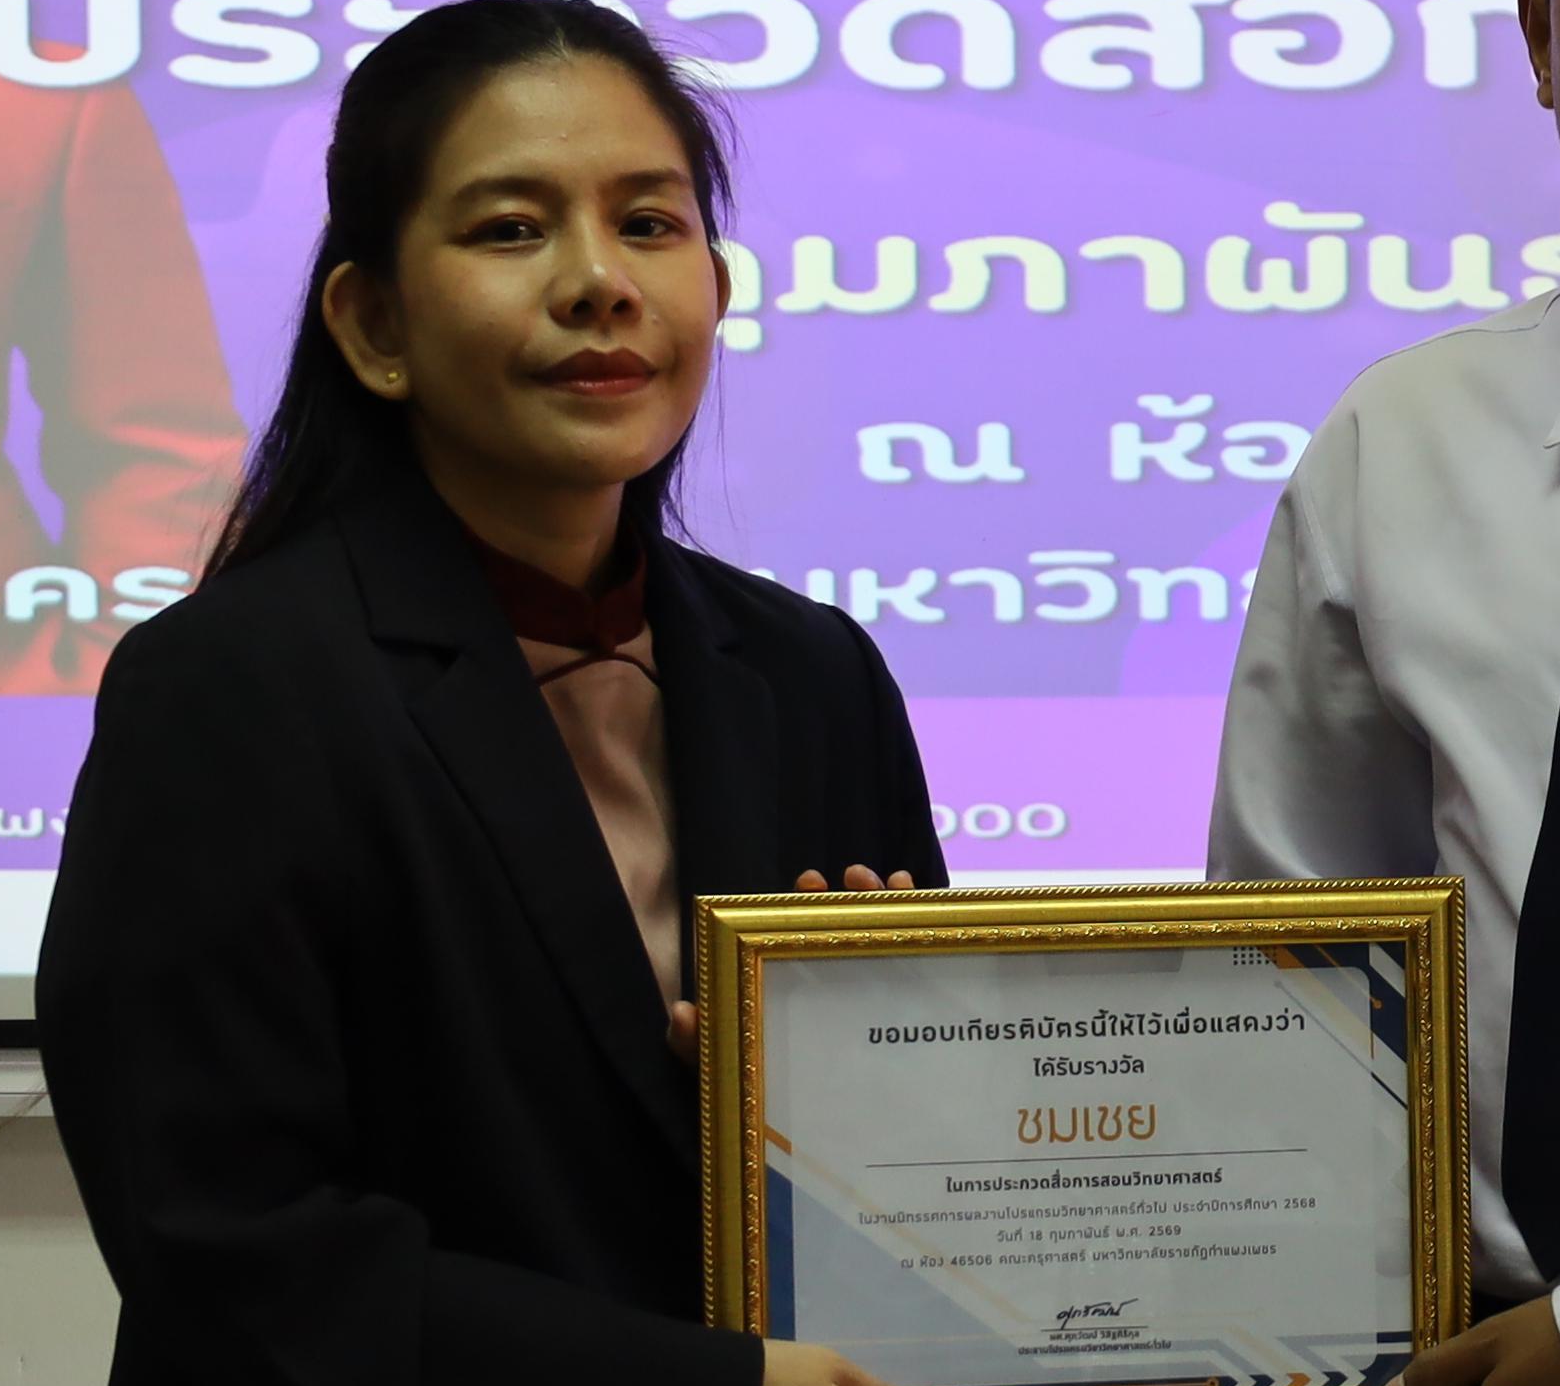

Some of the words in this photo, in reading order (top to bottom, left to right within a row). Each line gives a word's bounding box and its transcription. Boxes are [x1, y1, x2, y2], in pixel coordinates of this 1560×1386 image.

[857, 421, 1025, 483] ณ
[1110, 394, 1312, 481] ห้อ
[931, 803, 1066, 838] 000
[868, 1007, 1307, 1045] ขอมอบเกียรติบัตรนี้ให้ไว้เพื่อแสดงว่า
[1033, 1054, 1146, 1078] ได้รับรางวัล
[1017, 1103, 1157, 1145] ชมเชย
[946, 1167, 1224, 1194] ในการประกวดสื่อการสอนวิทยาศาสตร์
[1173, 1197, 1278, 1215] ประจำปีการศึกษา
[1284, 1197, 1316, 1210] 2568
[996, 1225, 1023, 1243] วันที่
[1148, 1224, 1181, 1237] 2569
